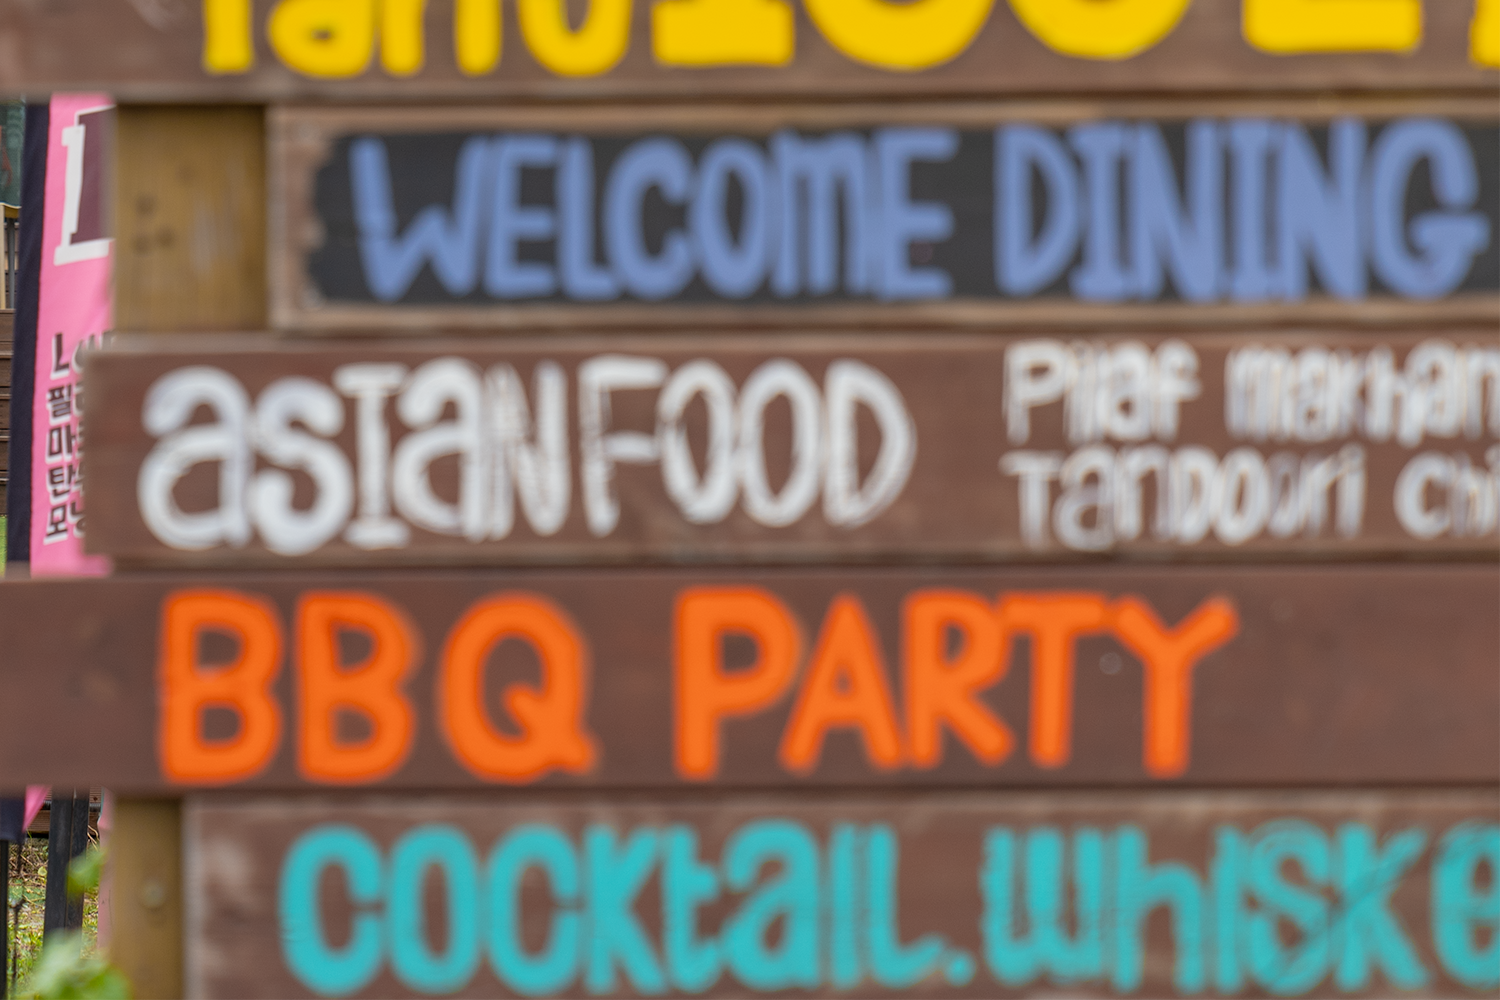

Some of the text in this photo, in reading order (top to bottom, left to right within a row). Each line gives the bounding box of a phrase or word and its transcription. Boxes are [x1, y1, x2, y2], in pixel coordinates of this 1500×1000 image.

[997, 117, 1489, 302] DINING
[161, 587, 1239, 781] BBQ PARTY
